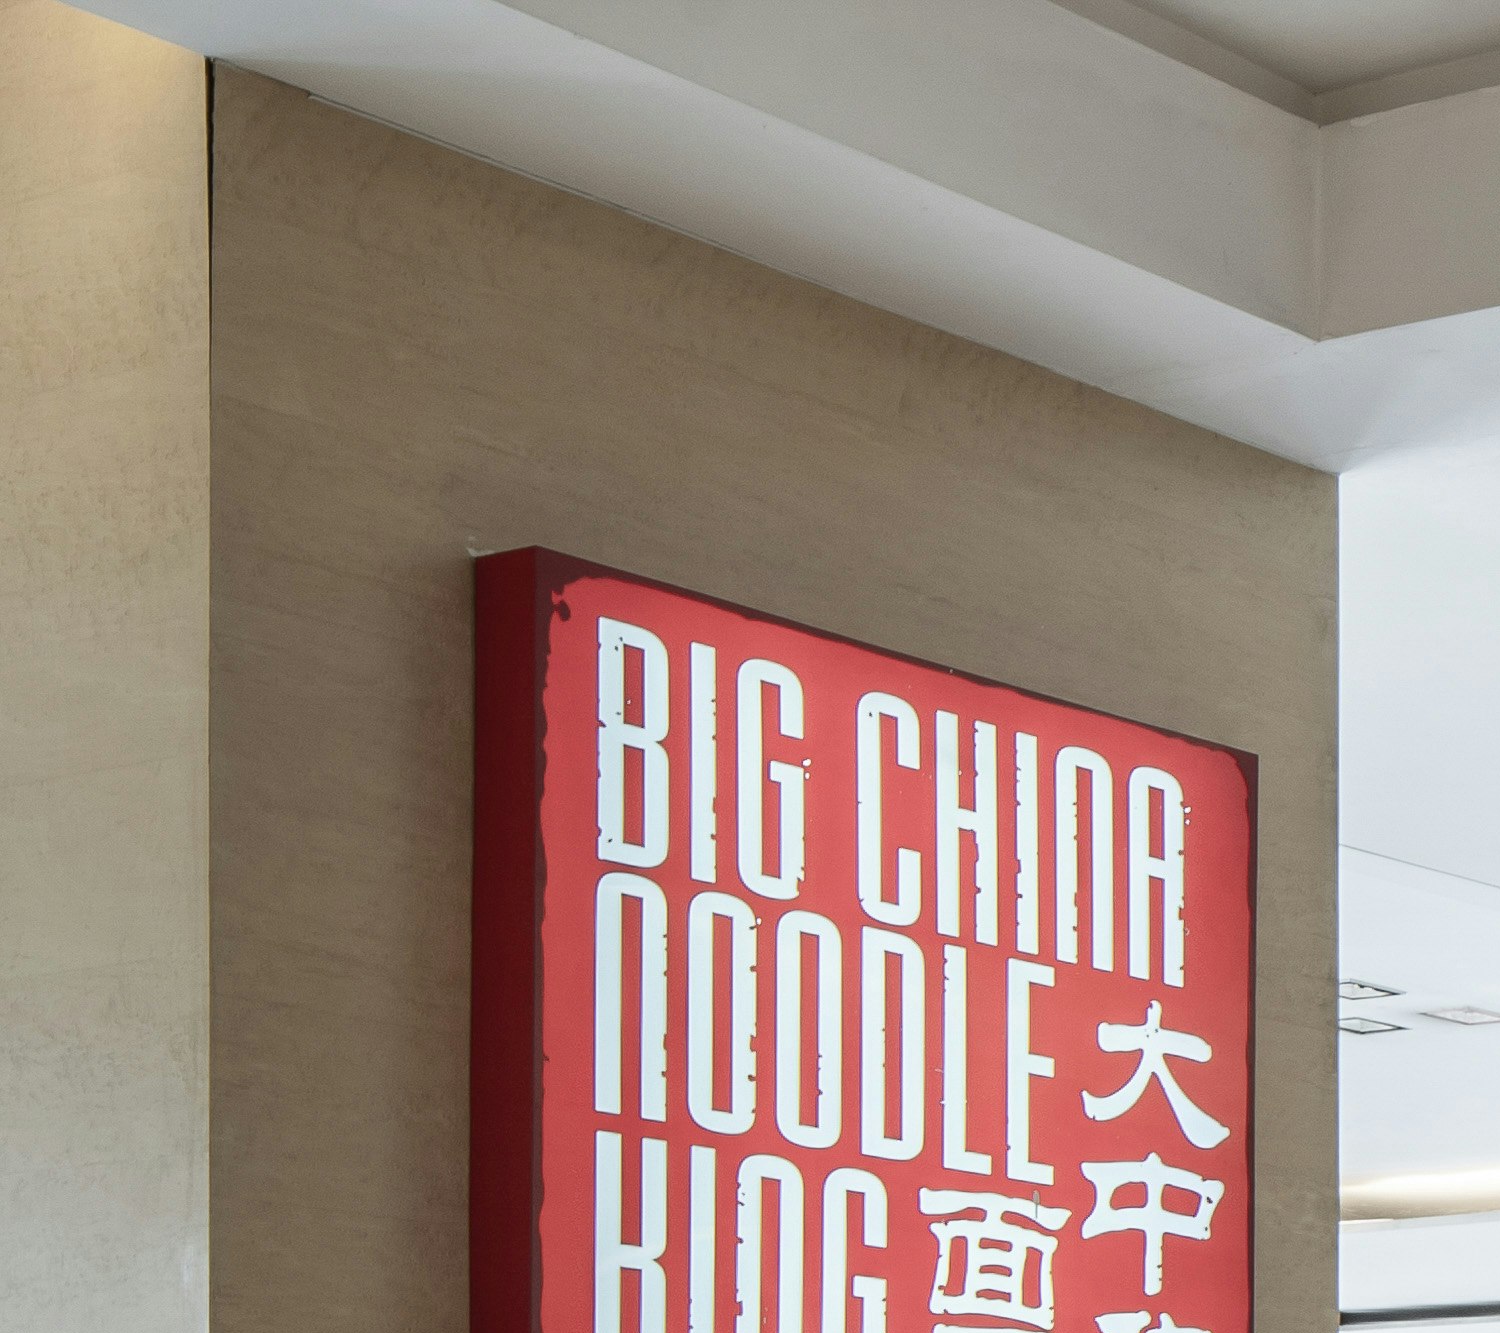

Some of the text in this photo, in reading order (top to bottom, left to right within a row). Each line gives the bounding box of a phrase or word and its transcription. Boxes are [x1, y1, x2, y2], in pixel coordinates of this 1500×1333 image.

[596, 616, 1192, 988] BIG CHINA
[594, 872, 1056, 1186] NOODLE
